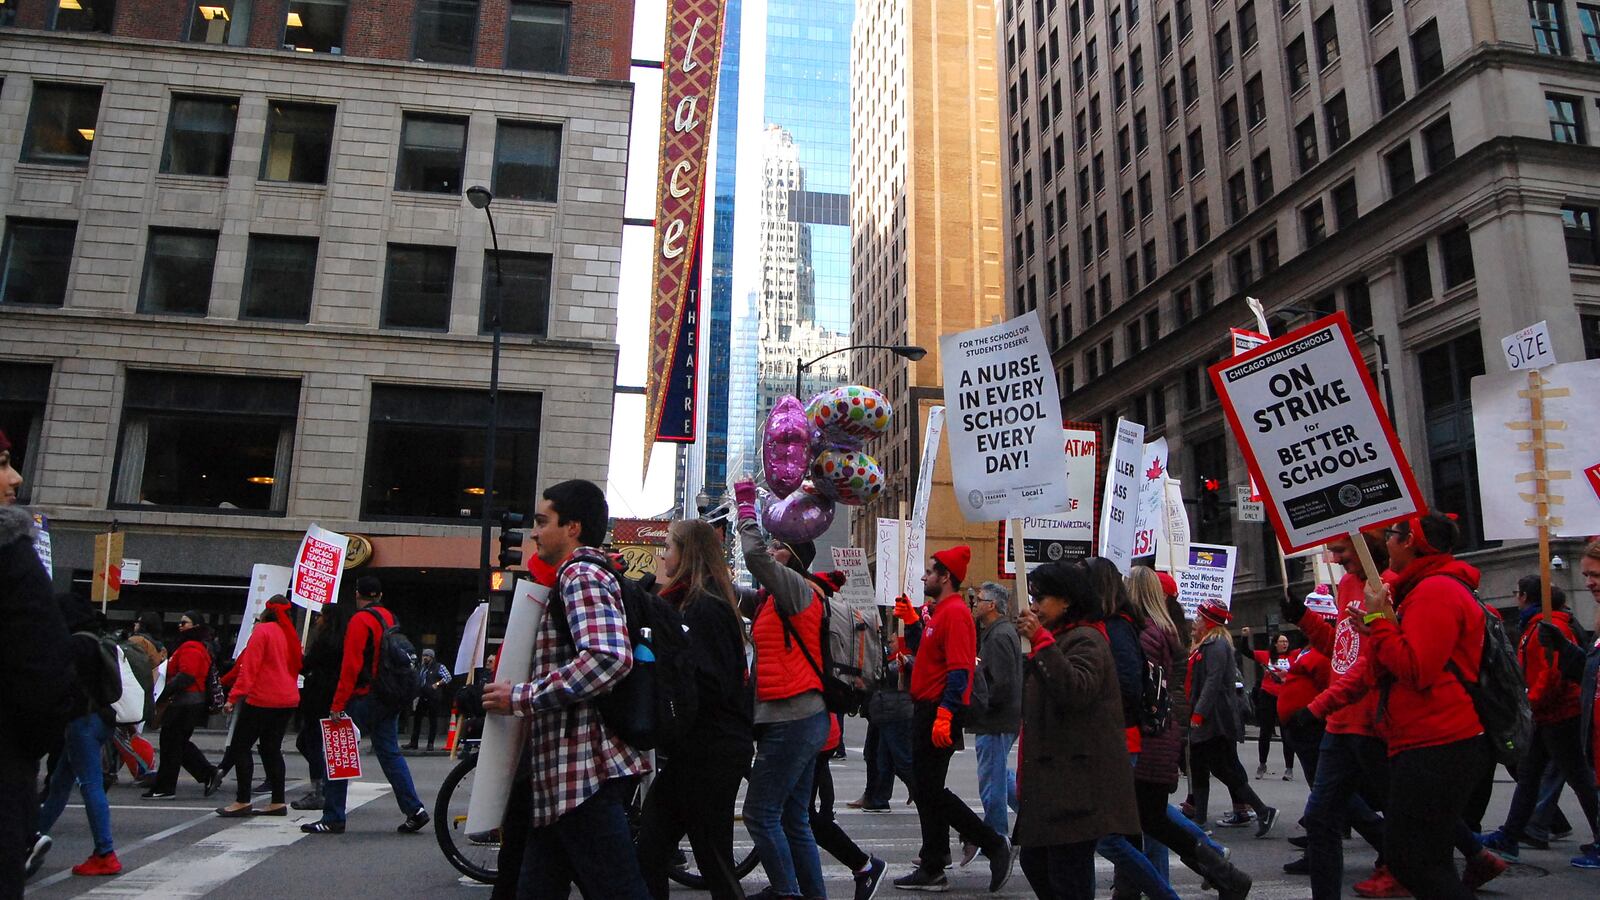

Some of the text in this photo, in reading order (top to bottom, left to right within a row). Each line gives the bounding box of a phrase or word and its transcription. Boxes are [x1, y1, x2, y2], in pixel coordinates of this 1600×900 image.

[959, 325, 1030, 349] FOR THE SCHOOLS OUR
[1515, 327, 1534, 340] CLASS
[966, 336, 1029, 357] STUDENTS DESERVE
[1229, 332, 1330, 379] CHICAGO PUBLIC SCHOOLS
[1507, 333, 1548, 369] SIZE
[684, 289, 697, 434] THEATRE
[960, 354, 1041, 388] A NURSE
[1268, 363, 1316, 398] ON
[959, 376, 1045, 410] IN EVERY
[963, 401, 1047, 432] SCHOOL
[1253, 378, 1351, 433] STRIKE
[1304, 422, 1320, 433] for
[977, 425, 1036, 453] EVERY
[1277, 424, 1360, 466] BETTER
[986, 450, 1029, 474] DAY!
[1278, 442, 1378, 489] SCHOOLS
[1021, 489, 1039, 497] Local
[1113, 483, 1127, 500] ASS
[1239, 487, 1250, 495] RIGH
[1362, 483, 1389, 494] TEACHERS
[307, 537, 314, 546] WE
[314, 540, 340, 554] SUPPORT
[309, 546, 333, 560] CHICAGO
[304, 559, 334, 573] AND STAFF
[306, 552, 334, 567] TEACHERS
[300, 566, 334, 584] WE SUPPORT
[302, 575, 327, 588] CHICAGO
[1181, 571, 1224, 583] School Workers
[298, 588, 327, 603] AND STAFF
[300, 581, 328, 597] TEACHERS
[1189, 581, 1210, 590] Strike
[1211, 583, 1223, 592] for:
[323, 722, 336, 776] WE SUPPORT
[331, 730, 342, 766] CHICAGO
[339, 727, 350, 769] TEACHERS
[346, 726, 358, 769] AND STAFF
